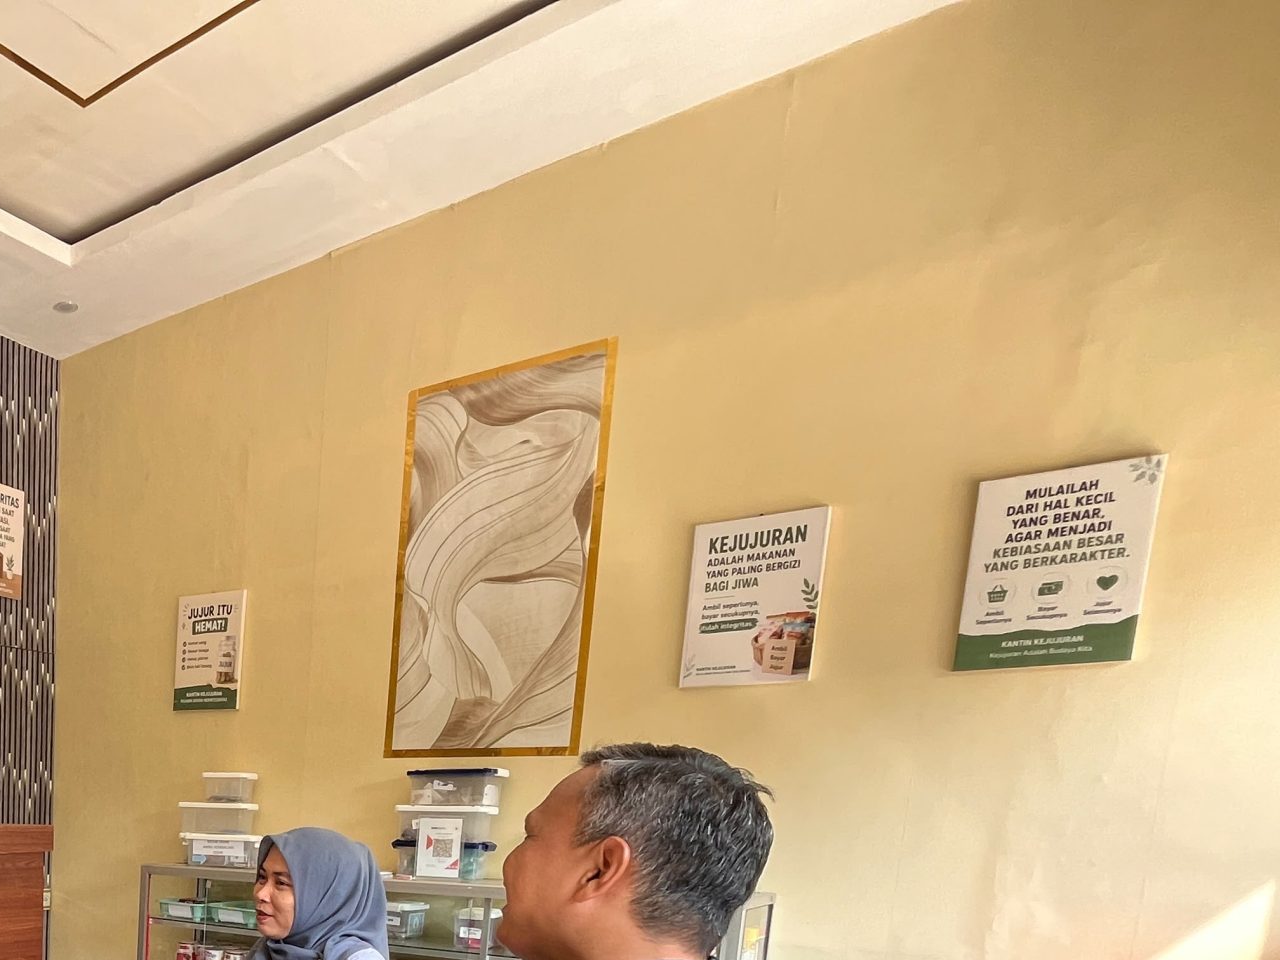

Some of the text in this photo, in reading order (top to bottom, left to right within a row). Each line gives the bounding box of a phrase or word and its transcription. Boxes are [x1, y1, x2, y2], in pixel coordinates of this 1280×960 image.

[1025, 479, 1100, 500] MULAILAH
[1007, 491, 1116, 517] DARI HAL KECIL
[1012, 508, 1105, 529] YANG BENAR,
[708, 524, 808, 555] KEJUJURAN
[1004, 520, 1113, 544] AGAR MENJADI
[992, 533, 1125, 560] KEBIASAAN BESAR
[707, 548, 796, 567] ADALAH MAKANAN
[984, 547, 1131, 574] YANG BERKARAKTER.
[706, 559, 801, 580] YANG PALING BERGIZI
[704, 577, 759, 593] BAGI JIWA
[187, 604, 233, 620] JUJUR ITU
[701, 611, 719, 621] bayar
[702, 602, 721, 612] Ambil
[194, 620, 226, 633] HEMAT!
[1001, 635, 1085, 648] KANTIN KEJUJURAN
